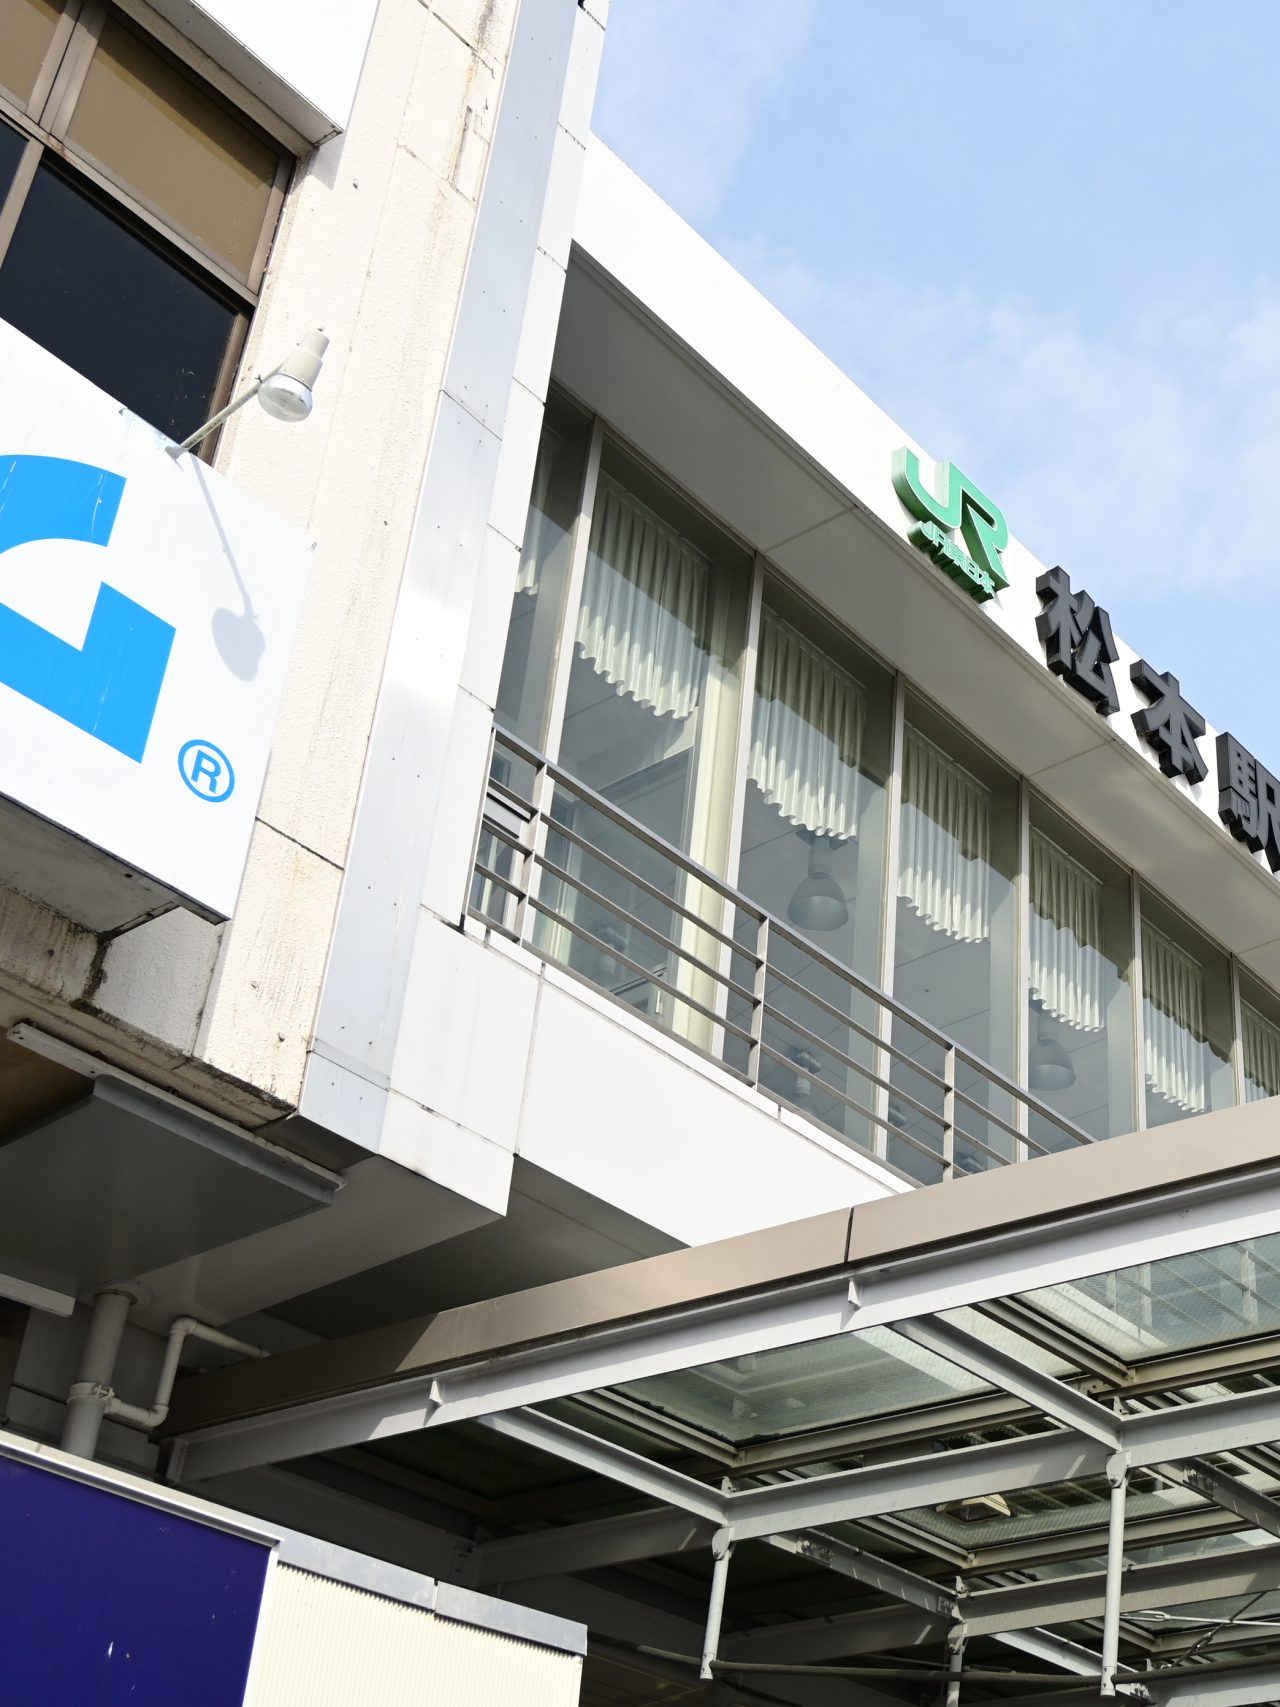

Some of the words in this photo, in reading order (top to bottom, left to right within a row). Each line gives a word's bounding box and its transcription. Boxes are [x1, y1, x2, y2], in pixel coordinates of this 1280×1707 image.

[892, 446, 1010, 590] JR
[909, 520, 996, 602] JR東日本
